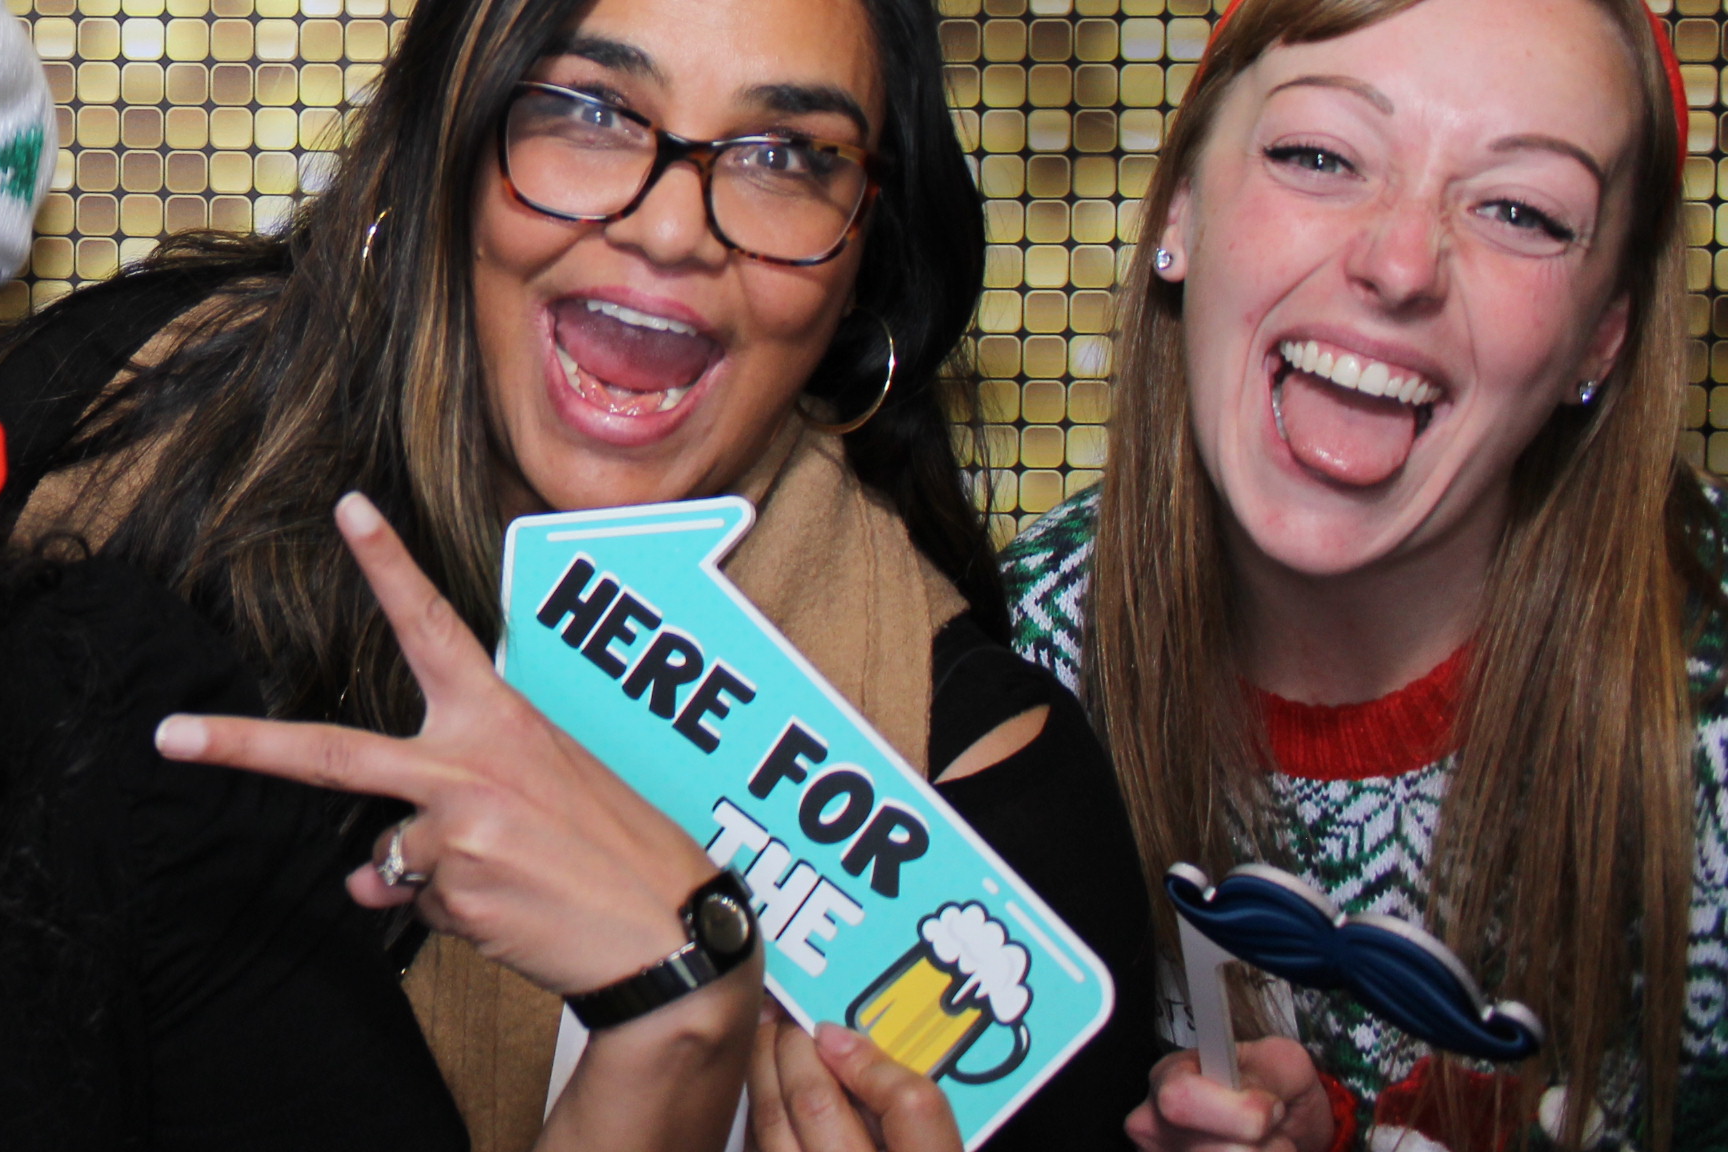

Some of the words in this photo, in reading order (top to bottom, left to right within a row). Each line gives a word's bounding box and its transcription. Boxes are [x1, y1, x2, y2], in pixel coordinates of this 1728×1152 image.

[535, 552, 757, 755] HERE
[747, 715, 930, 899] FOR
[707, 796, 865, 978] THE
